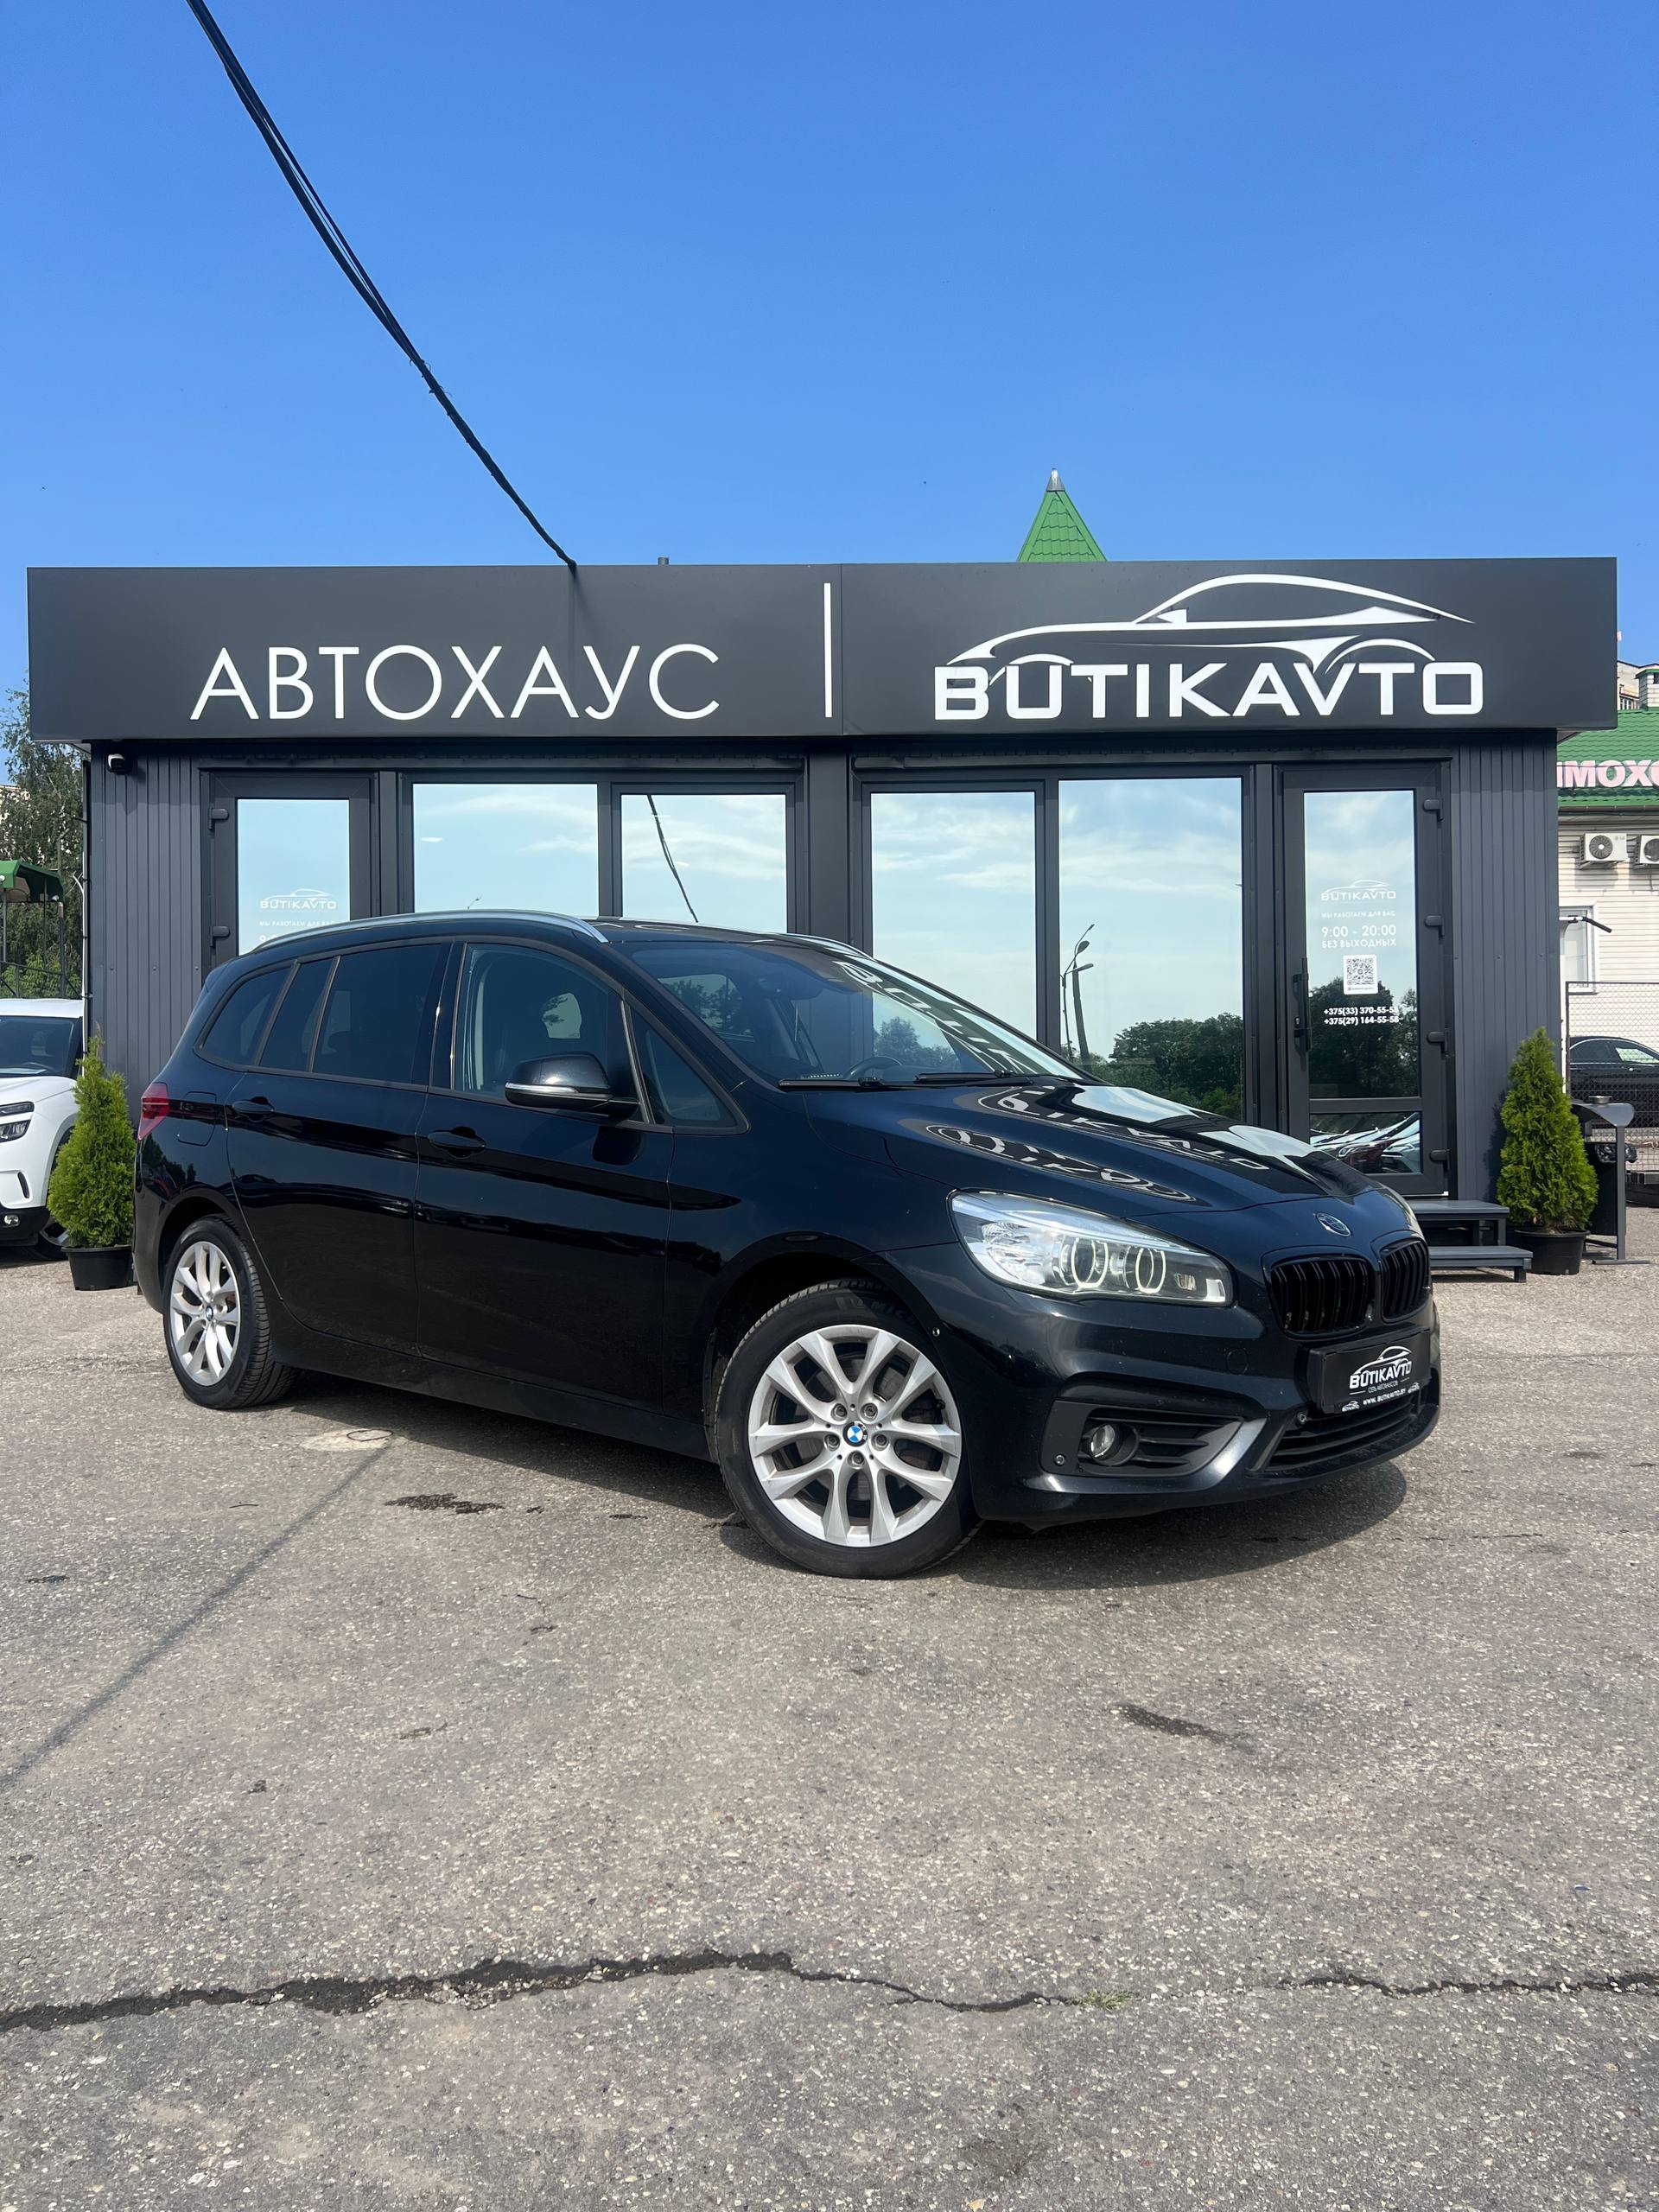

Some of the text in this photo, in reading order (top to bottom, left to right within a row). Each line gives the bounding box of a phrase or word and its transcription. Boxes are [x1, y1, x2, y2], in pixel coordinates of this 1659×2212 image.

[190, 643, 721, 721] АВТОХАУС
[934, 661, 1484, 721] BUTIKAVTO
[1557, 760, 1659, 787] МОХ
[1321, 891, 1396, 900] BUTIKAVTO
[260, 899, 337, 909] BUTIKAVTO
[1321, 925, 1349, 938] 9:00
[1362, 924, 1396, 937] 20:00
[1321, 938, 1396, 949] БЕЗ ВЫХОДНЫХ
[1324, 1007, 1358, 1016] +375(33)
[1324, 1017, 1359, 1026] +375(29)
[1349, 1361, 1413, 1389] BUTIKAVTO
